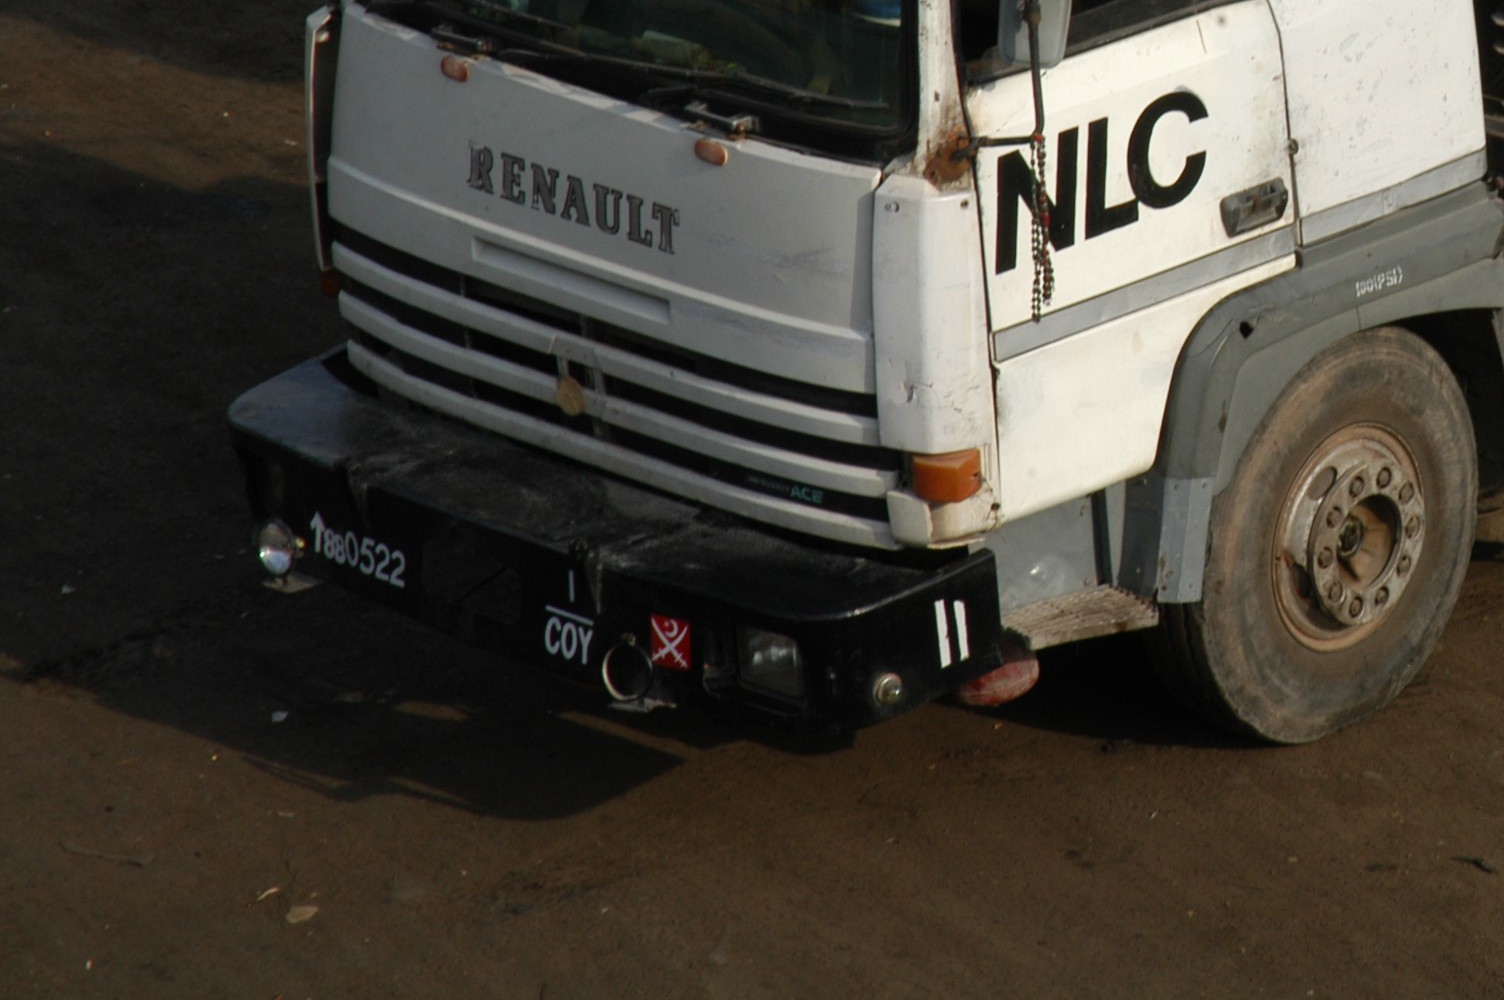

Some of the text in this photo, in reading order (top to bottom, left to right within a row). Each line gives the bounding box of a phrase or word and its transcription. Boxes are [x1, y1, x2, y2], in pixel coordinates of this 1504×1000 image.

[466, 143, 681, 255] RENAULT
[995, 90, 1209, 276] NLC
[544, 616, 594, 665] COY
